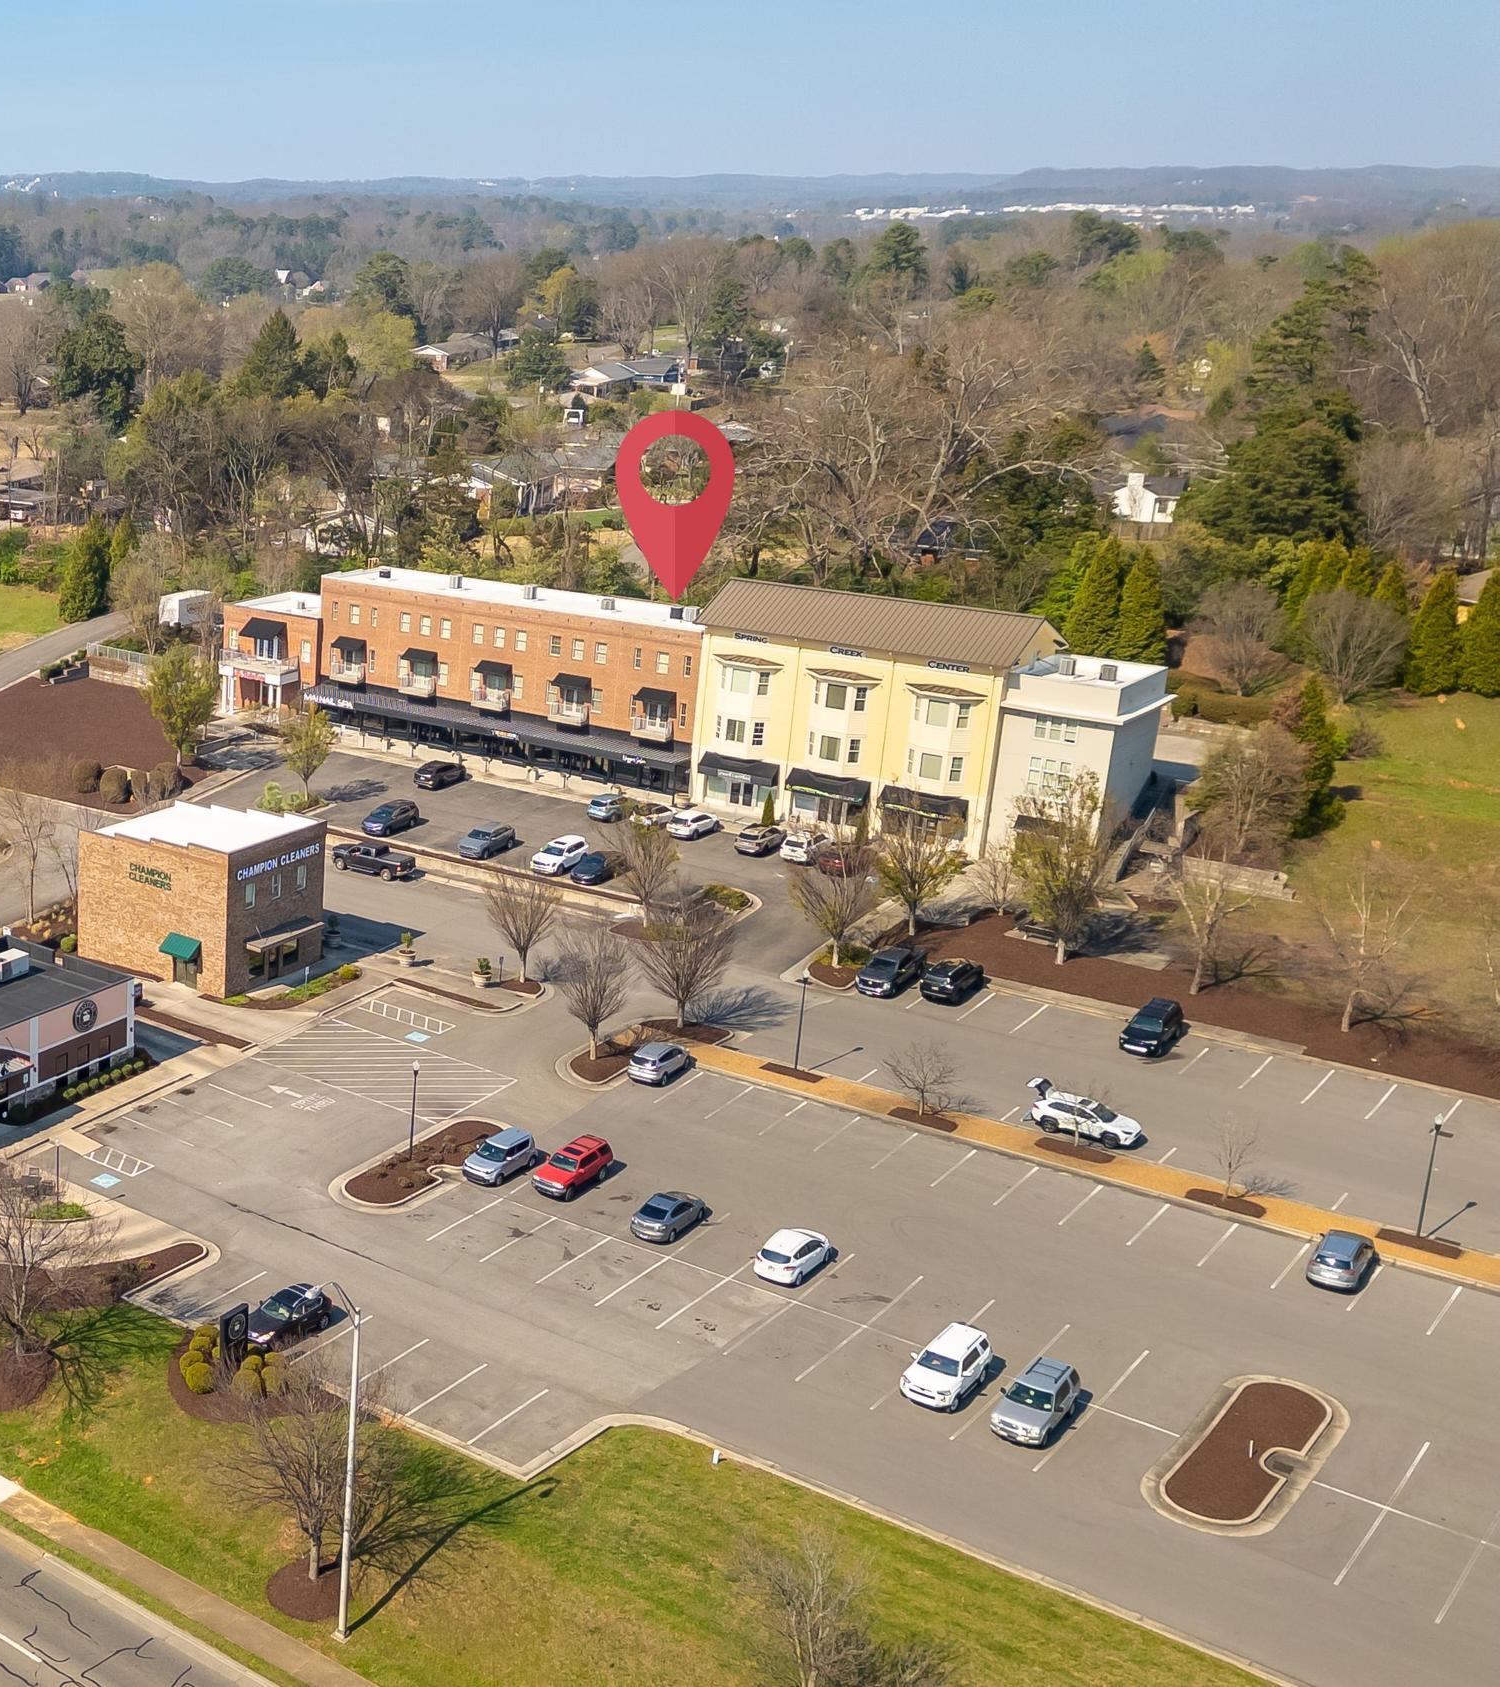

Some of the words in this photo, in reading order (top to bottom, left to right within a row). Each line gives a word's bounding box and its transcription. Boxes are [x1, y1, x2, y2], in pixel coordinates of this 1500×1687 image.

[830, 646, 863, 658] CREEK
[928, 660, 970, 673] CENTER
[236, 858, 278, 881] CHAMPION
[280, 843, 320, 866] CLEANERS
[129, 862, 172, 882] CHAMPION
[129, 871, 172, 891] CLEANERS
[291, 1093, 326, 1110] DRIVE
[303, 1097, 337, 1112] THRU
